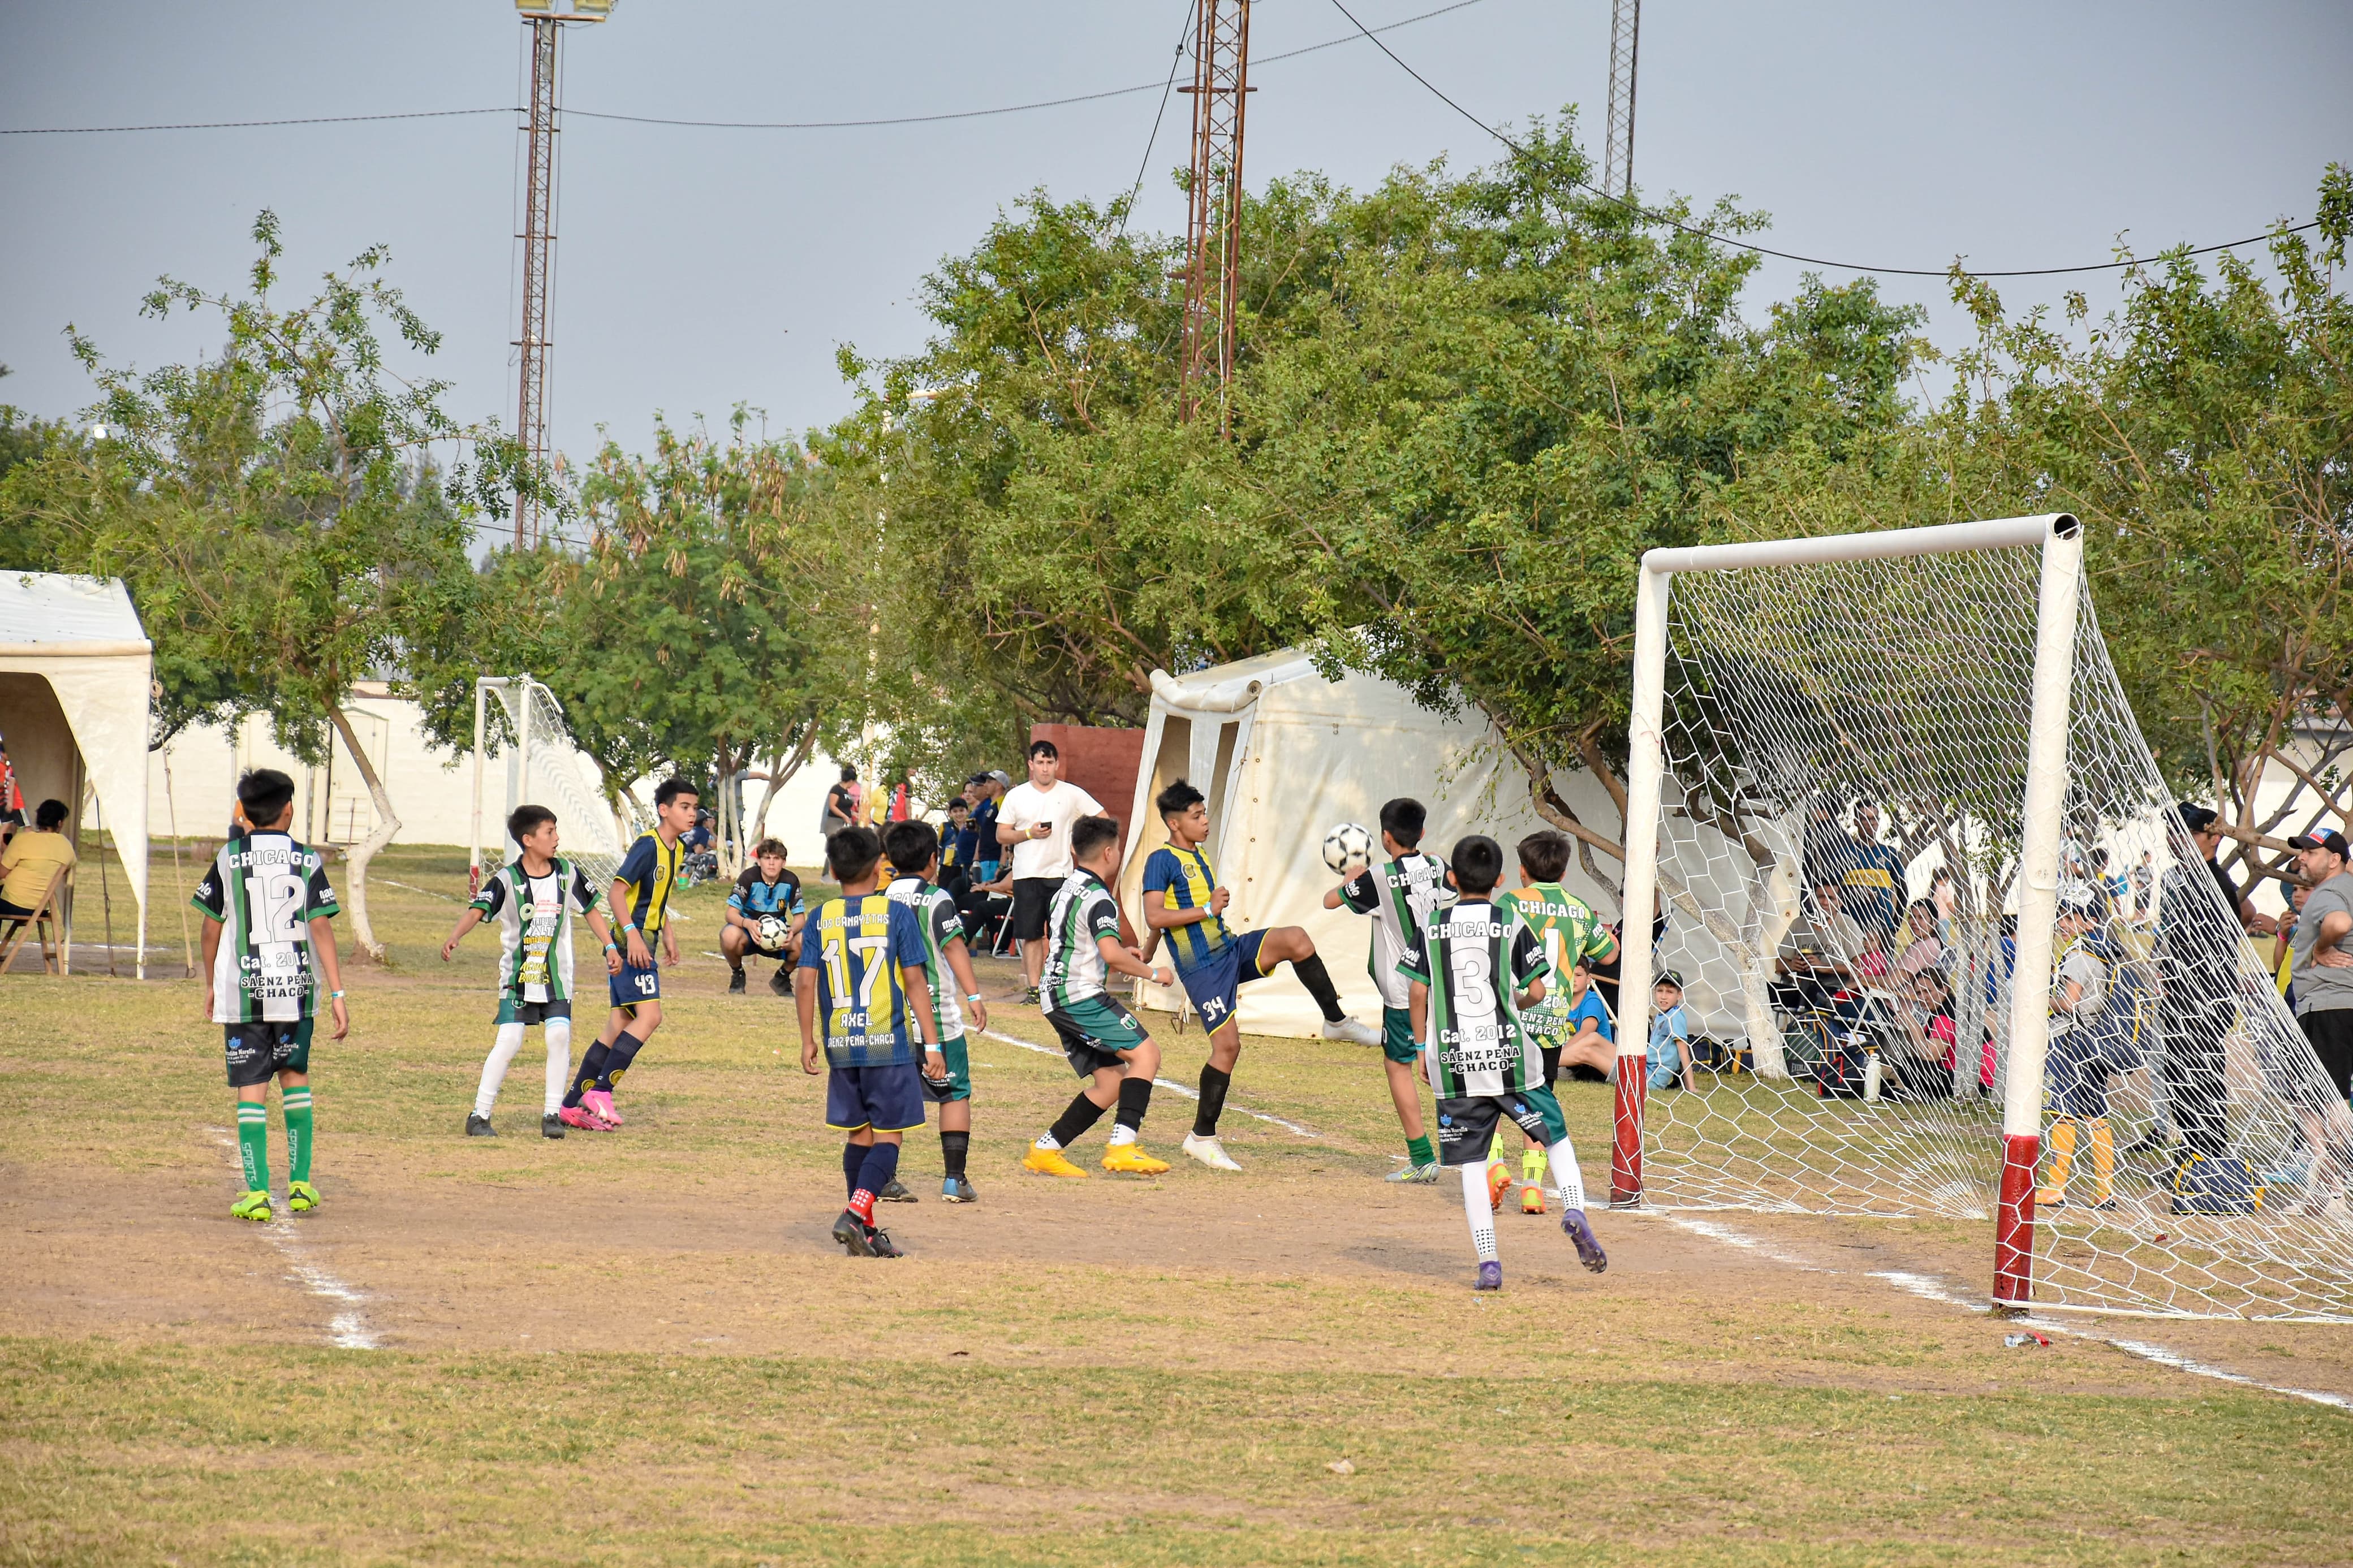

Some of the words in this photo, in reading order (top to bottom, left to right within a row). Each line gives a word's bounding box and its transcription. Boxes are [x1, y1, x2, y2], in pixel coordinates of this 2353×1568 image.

[229, 849, 313, 869] CHICAGO
[1386, 865, 1441, 888] CHICAGO
[245, 874, 307, 945] 12
[1518, 900, 1586, 919] CHICAGO
[817, 919, 833, 930] LOS
[1427, 921, 1513, 939] CHICAGO
[240, 955, 272, 969] Cat.
[276, 951, 309, 967] 2012
[1540, 927, 1560, 989] 1
[241, 973, 283, 988] SÁENZ
[286, 971, 314, 985] PEÑA
[820, 936, 888, 1009] 17
[1450, 947, 1497, 1017] 3
[634, 974, 656, 995] 43
[1203, 995, 1227, 1022] 34
[1521, 1012, 1544, 1024] ENZ
[841, 1013, 873, 1027] AXEL
[1440, 1029, 1471, 1043] Cat.
[1475, 1024, 1517, 1042] 2012
[1441, 1048, 1483, 1064] SÁENZ
[1485, 1044, 1521, 1060] PEÑA
[242, 1142, 257, 1182] SPORTS
